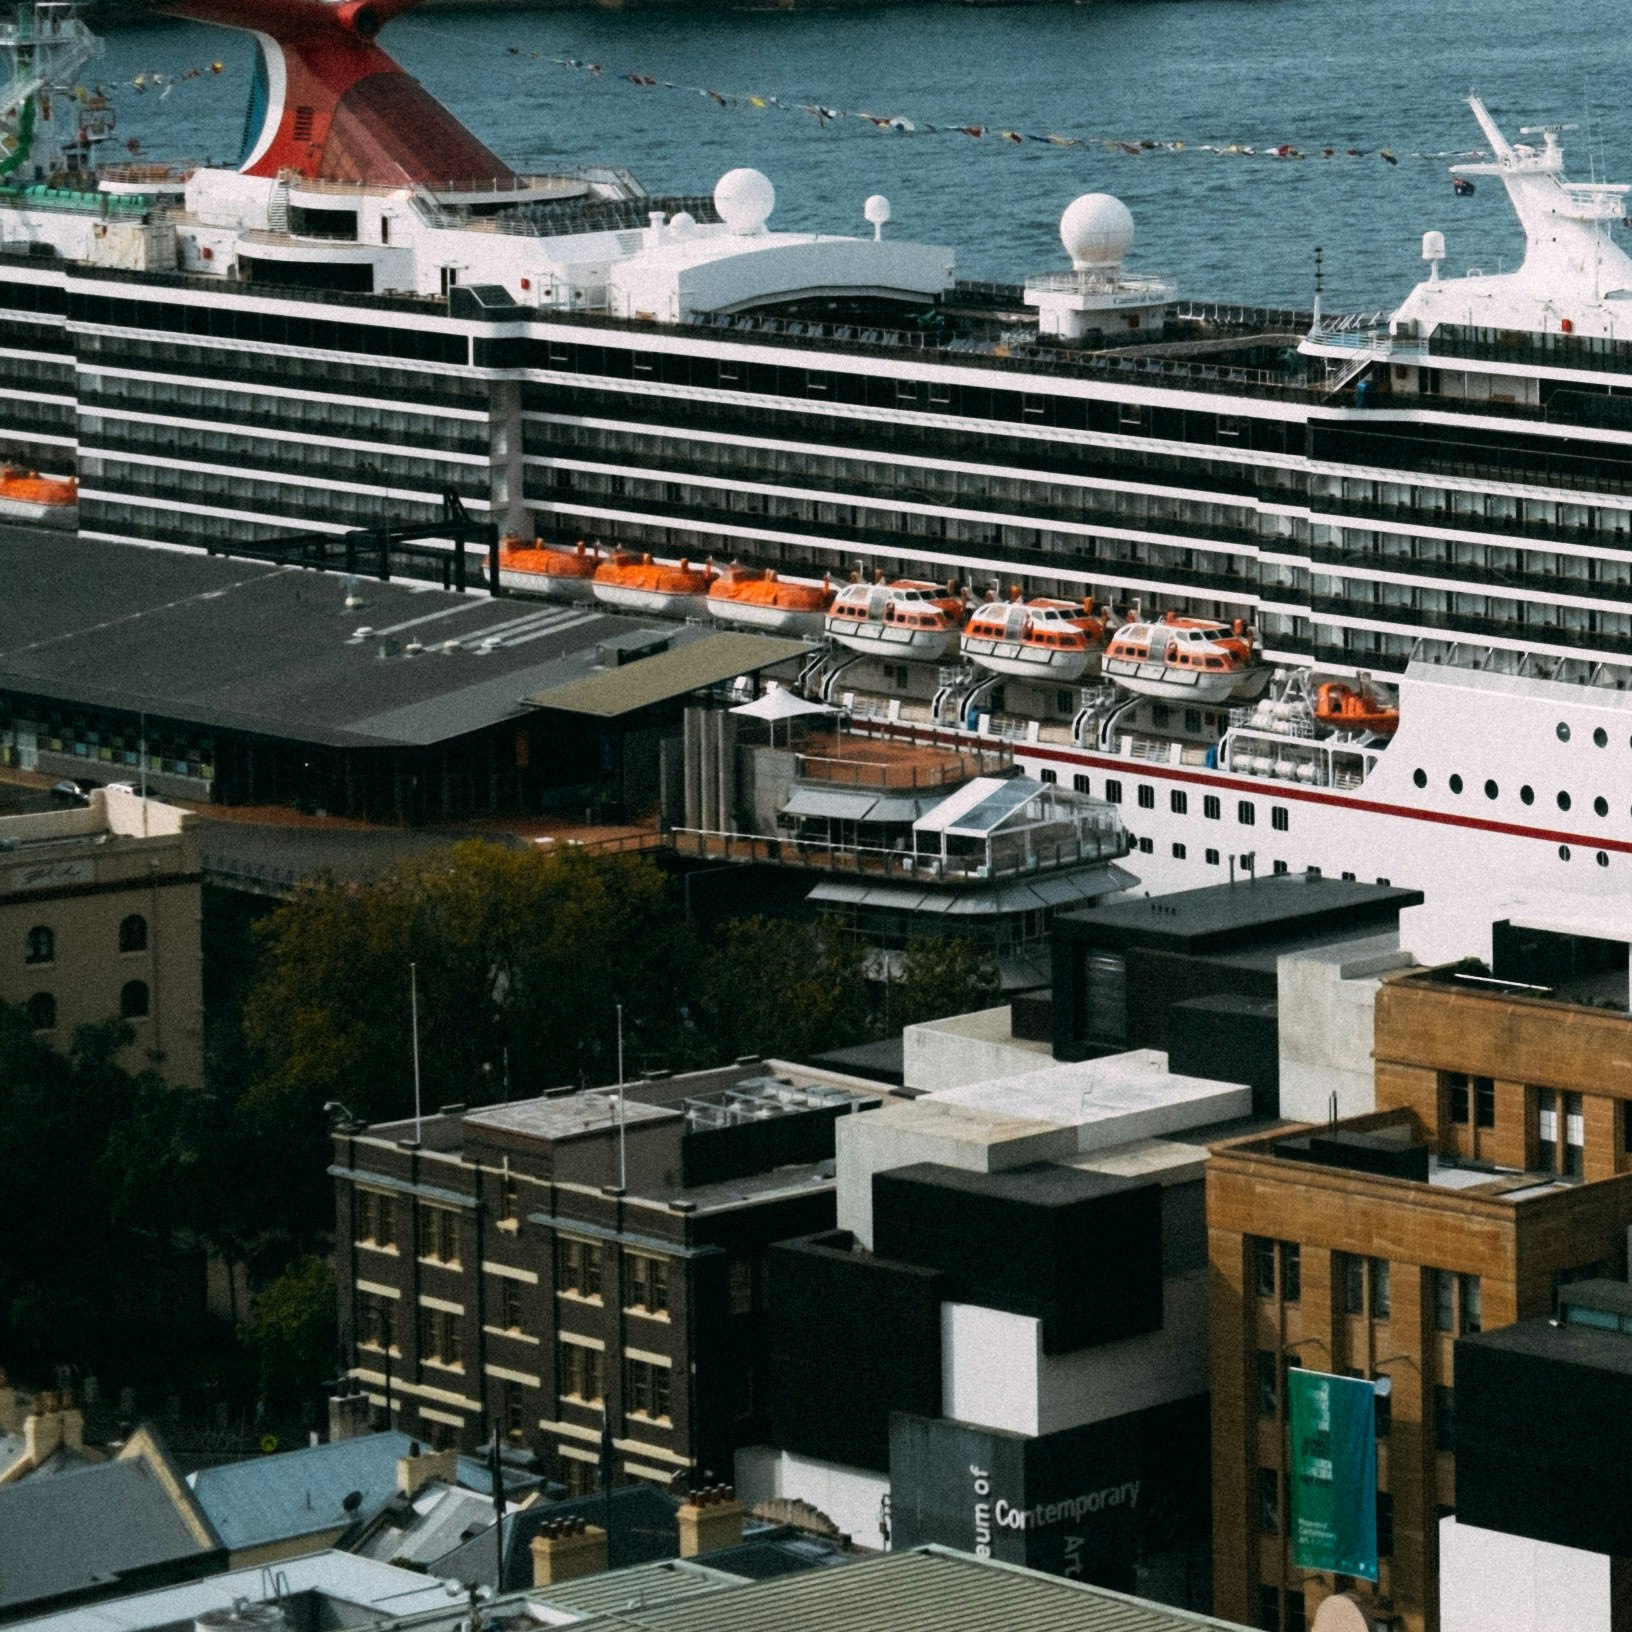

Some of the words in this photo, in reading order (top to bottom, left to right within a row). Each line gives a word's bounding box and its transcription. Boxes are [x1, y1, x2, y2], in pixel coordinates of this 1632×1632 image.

[970, 1464, 990, 1495] of
[995, 1480, 1141, 1530] Contemporary
[975, 1503, 992, 1559] eum
[1064, 1535, 1087, 1578] Art
